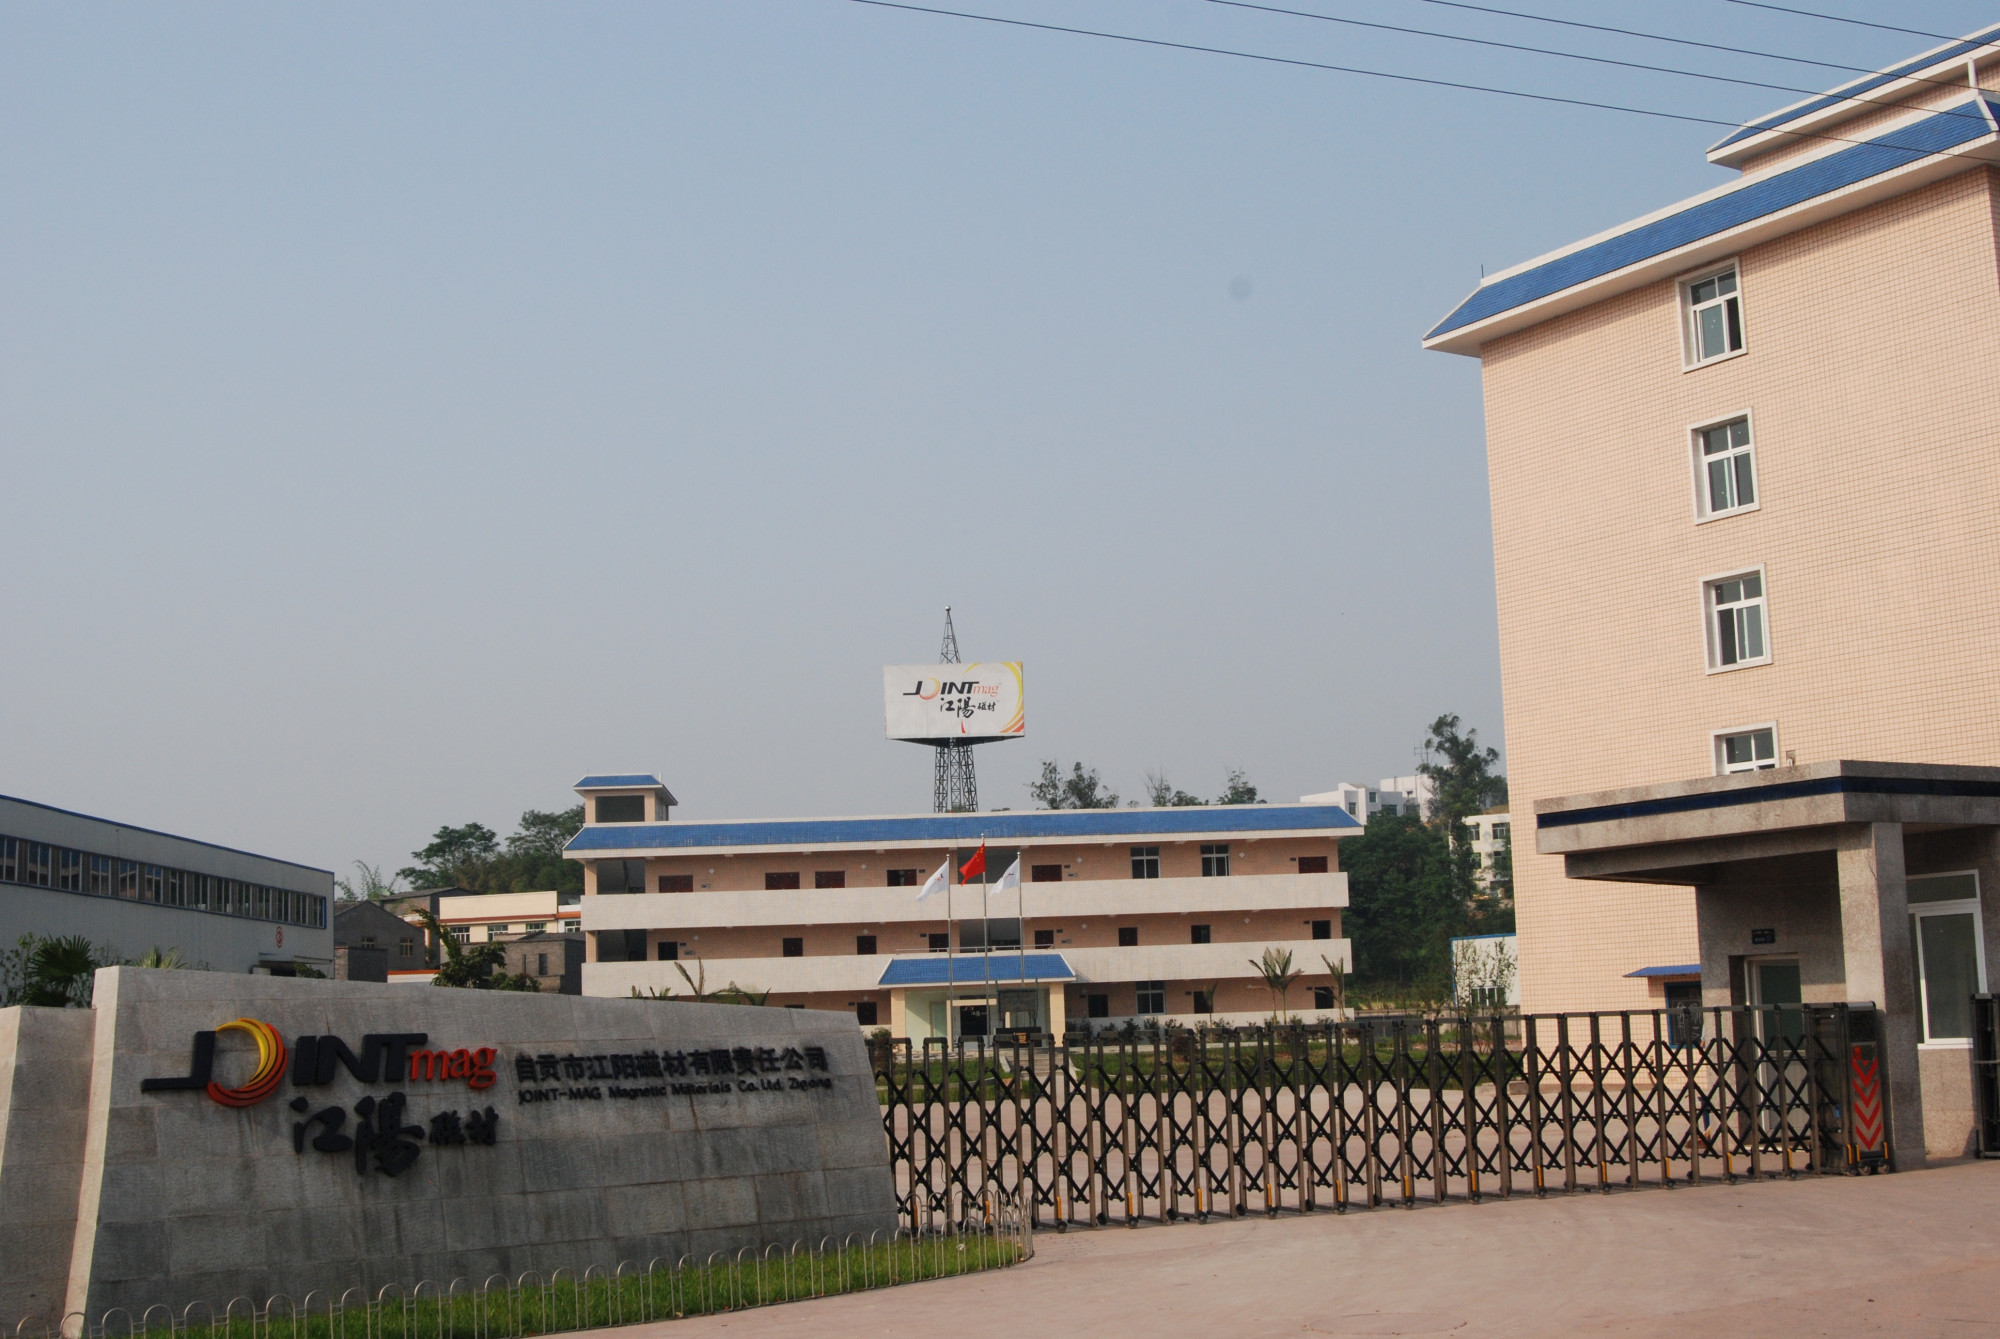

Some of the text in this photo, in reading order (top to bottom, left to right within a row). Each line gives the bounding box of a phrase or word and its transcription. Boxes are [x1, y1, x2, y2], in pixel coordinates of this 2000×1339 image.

[514, 1046, 829, 1082] 自贡市江阳磁材有限责任公司
[518, 1087, 602, 1105] JOINT-MAG
[608, 1085, 666, 1099] Magnetic
[671, 1082, 731, 1096] Materials
